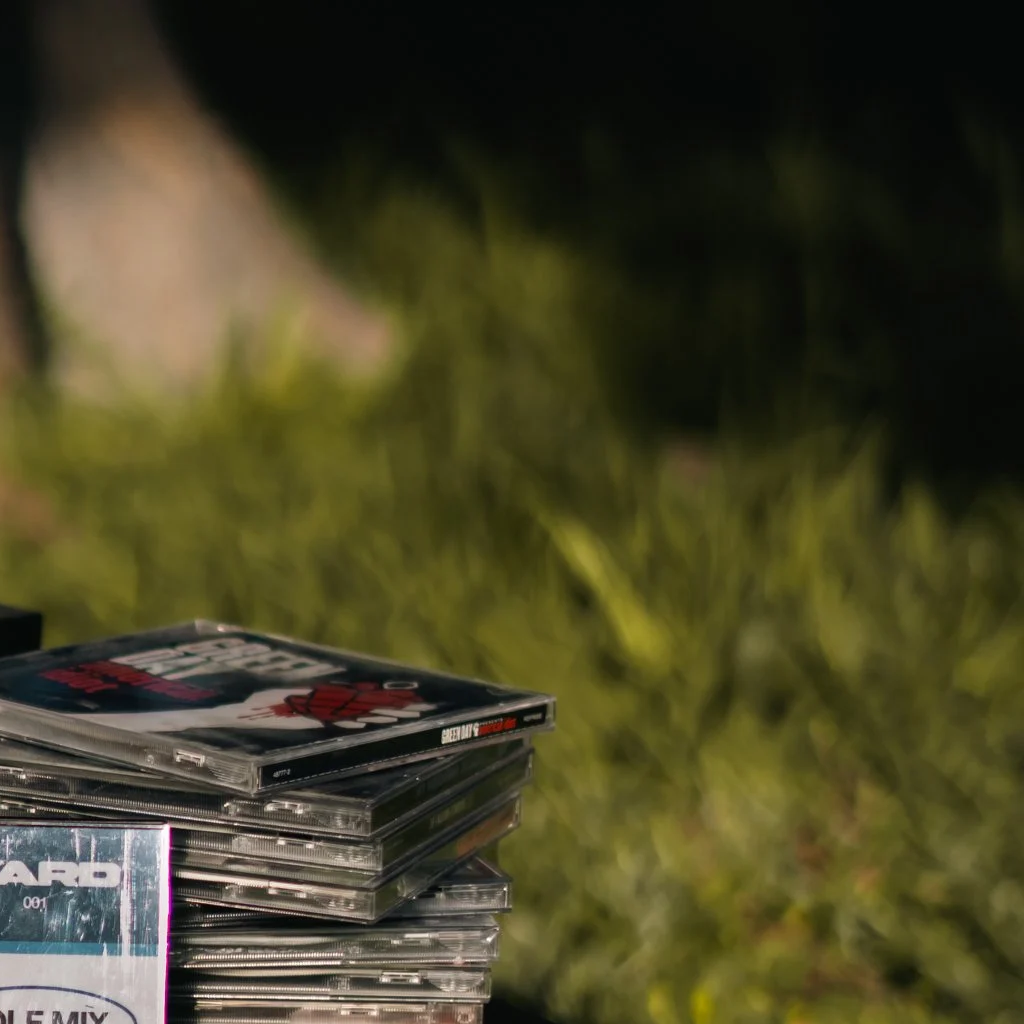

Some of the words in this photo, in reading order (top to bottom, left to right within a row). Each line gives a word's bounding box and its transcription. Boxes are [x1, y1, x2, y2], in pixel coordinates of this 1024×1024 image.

[441, 728, 461, 744] GREEN
[461, 724, 473, 740] DAY
[23, 897, 46, 909] 001
